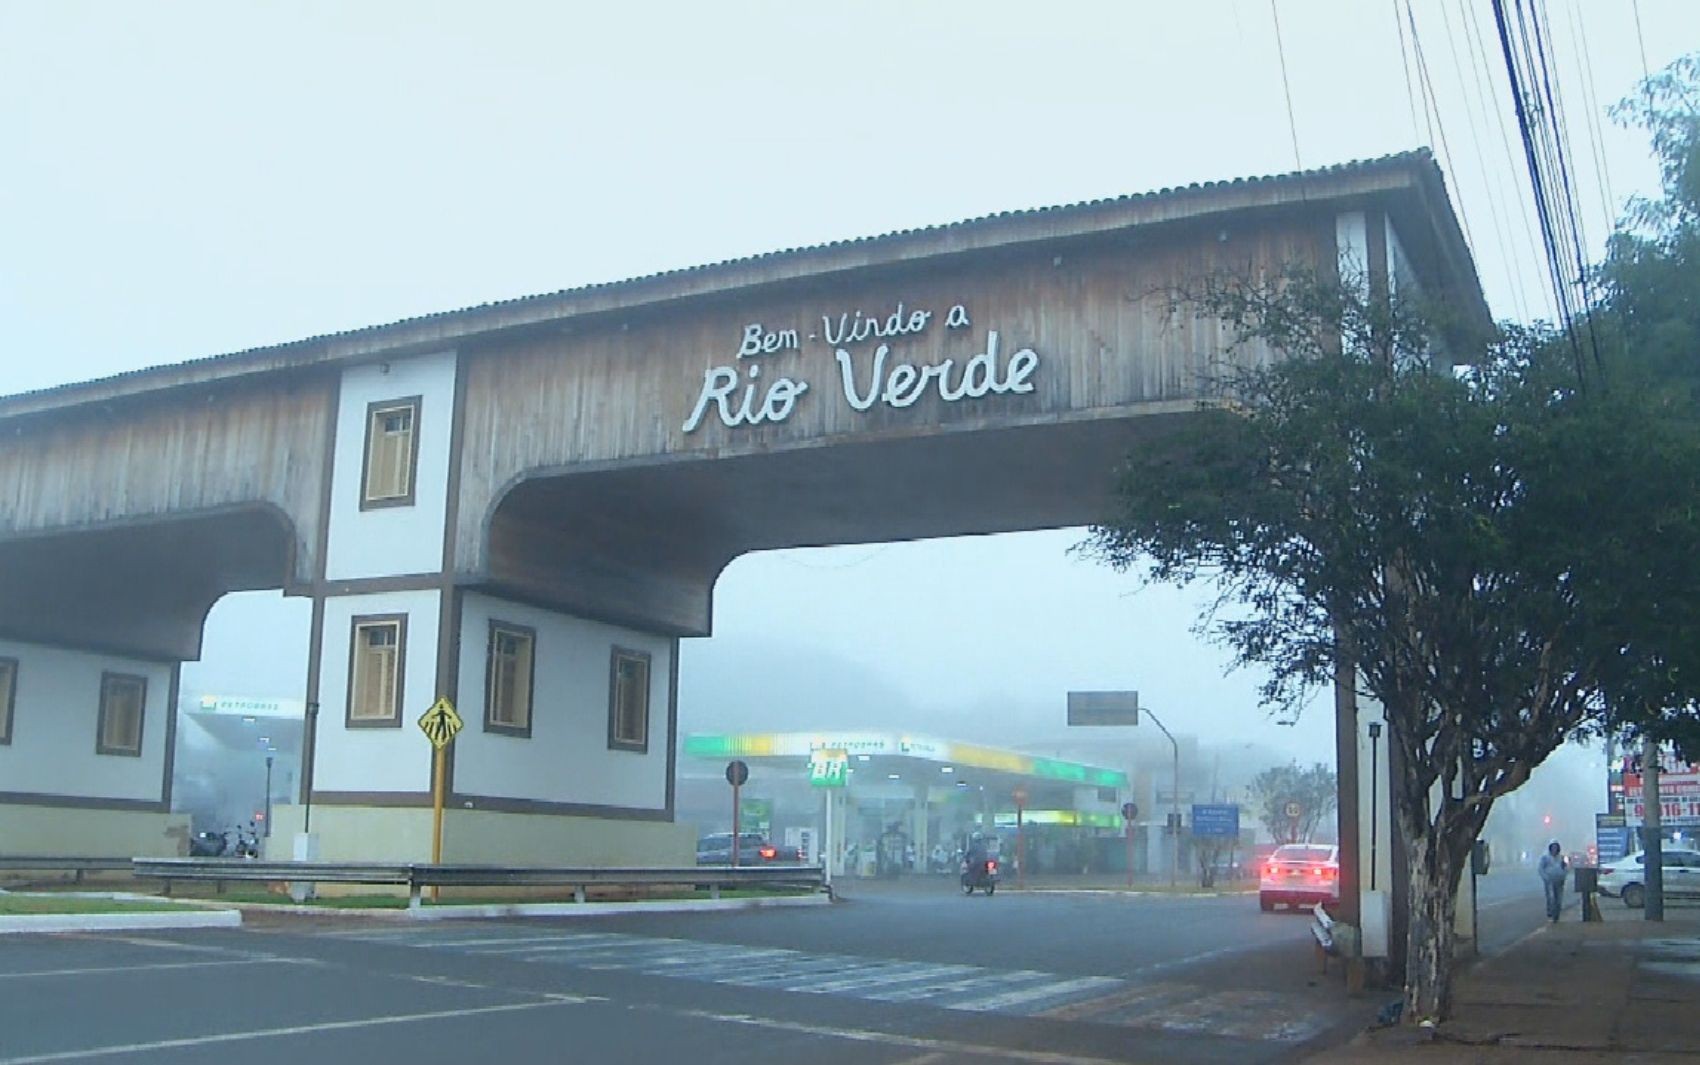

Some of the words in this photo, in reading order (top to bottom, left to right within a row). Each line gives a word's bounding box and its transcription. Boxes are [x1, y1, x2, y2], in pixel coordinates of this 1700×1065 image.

[736, 323, 798, 358] Bem
[822, 301, 931, 344] Vindo
[944, 304, 970, 328] a
[682, 364, 808, 433] Rio
[834, 330, 1039, 410] Verde
[812, 760, 843, 779] BR
